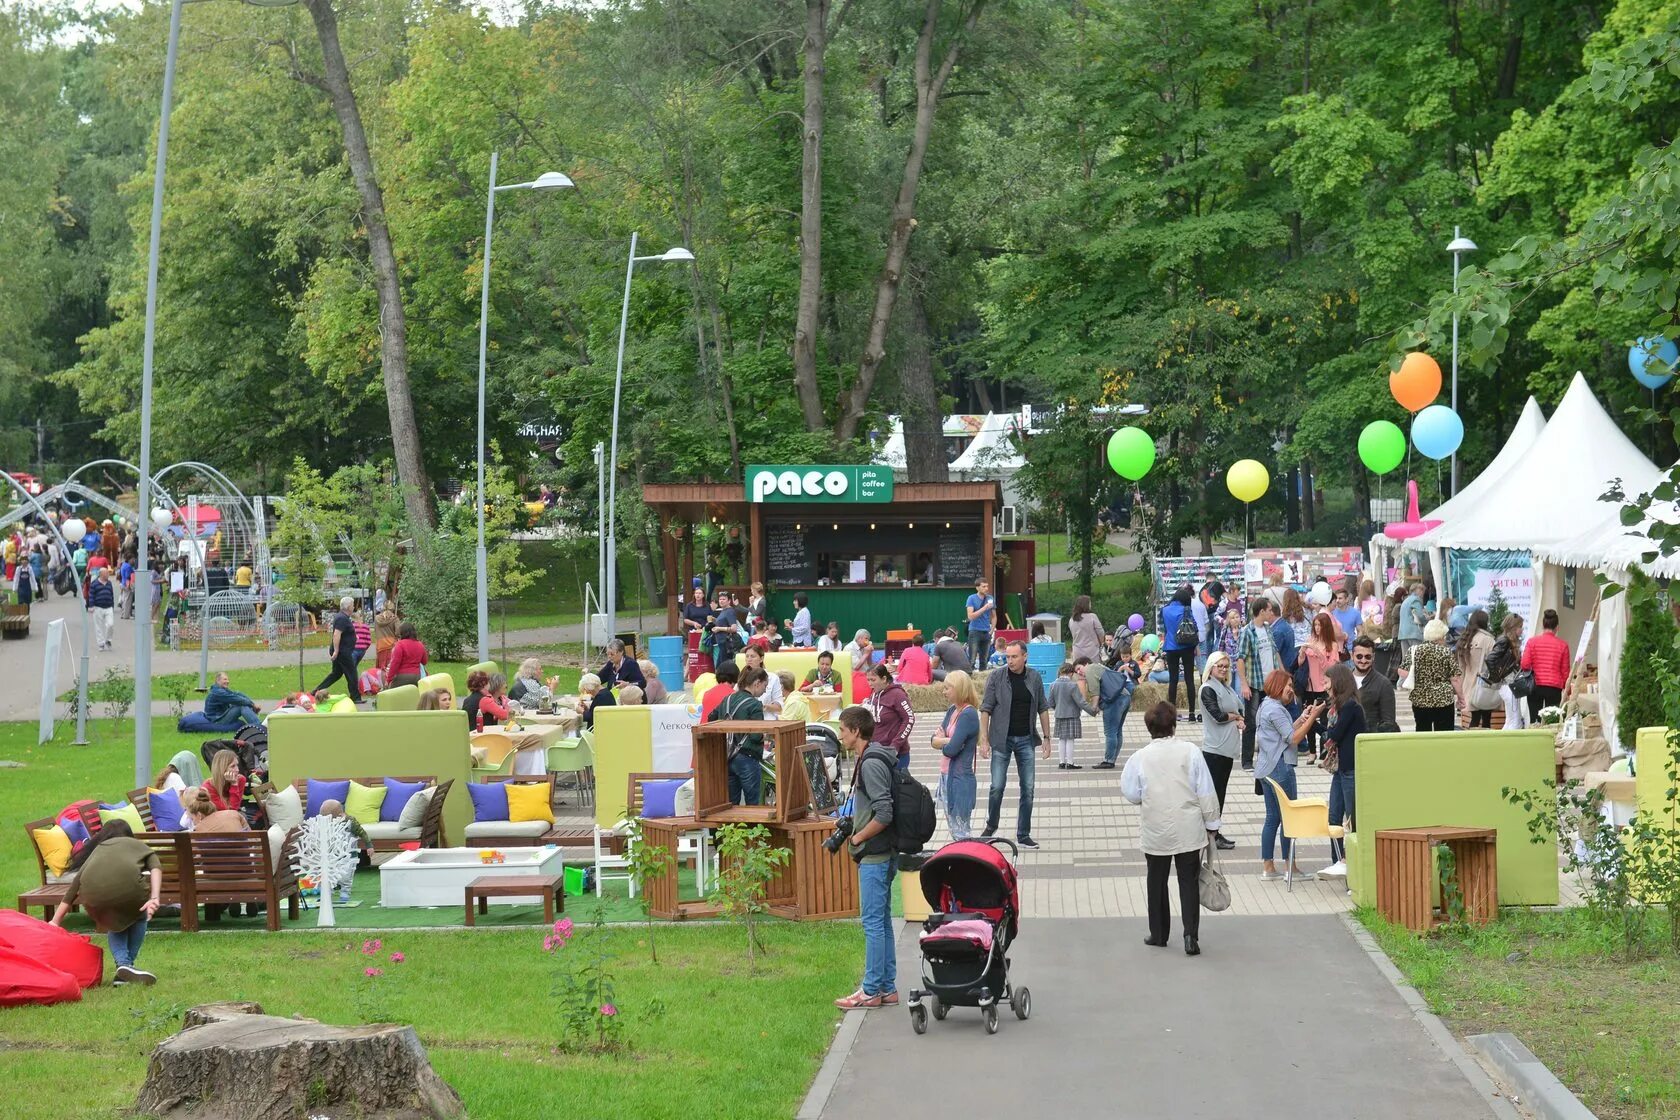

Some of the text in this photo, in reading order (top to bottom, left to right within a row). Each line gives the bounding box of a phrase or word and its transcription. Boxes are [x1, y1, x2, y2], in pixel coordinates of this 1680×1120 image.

[862, 471, 876, 480] pita
[753, 470, 848, 502] paco
[862, 480, 885, 488] coffee
[862, 489, 875, 497] bar
[1490, 578, 1533, 588] ХИТЫ М
